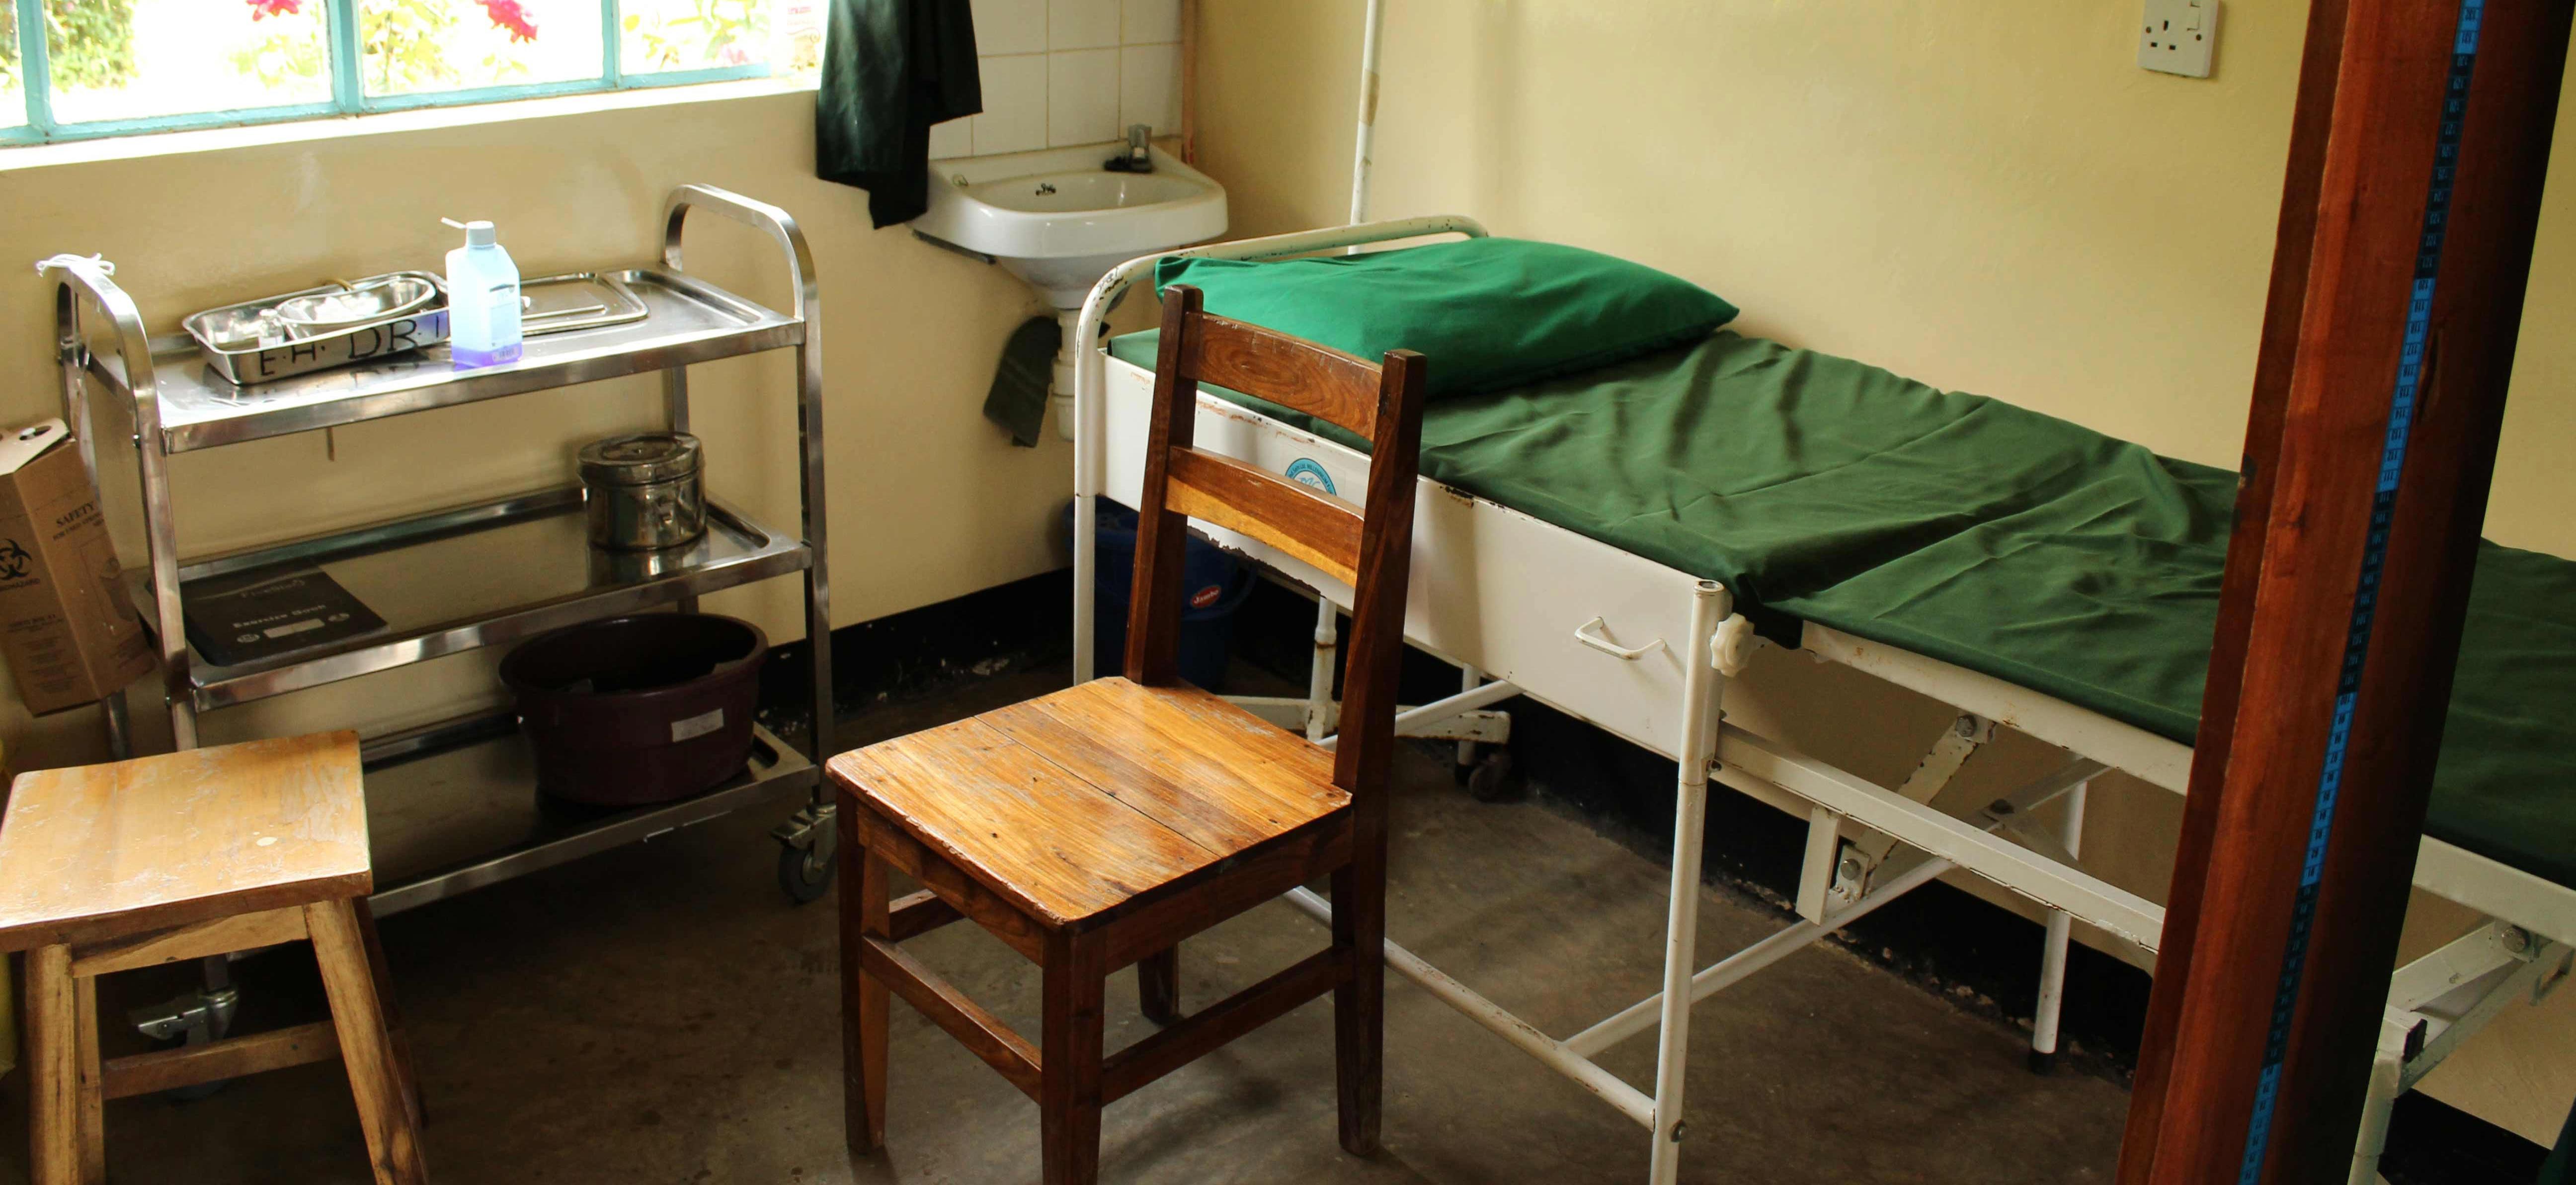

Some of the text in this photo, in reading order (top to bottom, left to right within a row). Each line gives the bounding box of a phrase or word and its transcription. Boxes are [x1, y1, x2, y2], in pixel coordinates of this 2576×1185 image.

[2418, 280, 2428, 290] 120
[2415, 301, 2425, 312] 119
[2411, 322, 2420, 333] 118
[2407, 344, 2417, 354] 117
[2404, 366, 2413, 375] 116
[2400, 388, 2409, 397] 115
[2396, 409, 2405, 419] 114
[2391, 430, 2401, 440] 113
[2387, 450, 2397, 461] 112
[2384, 472, 2393, 481] 111
[57, 501, 94, 527] SAFETY
